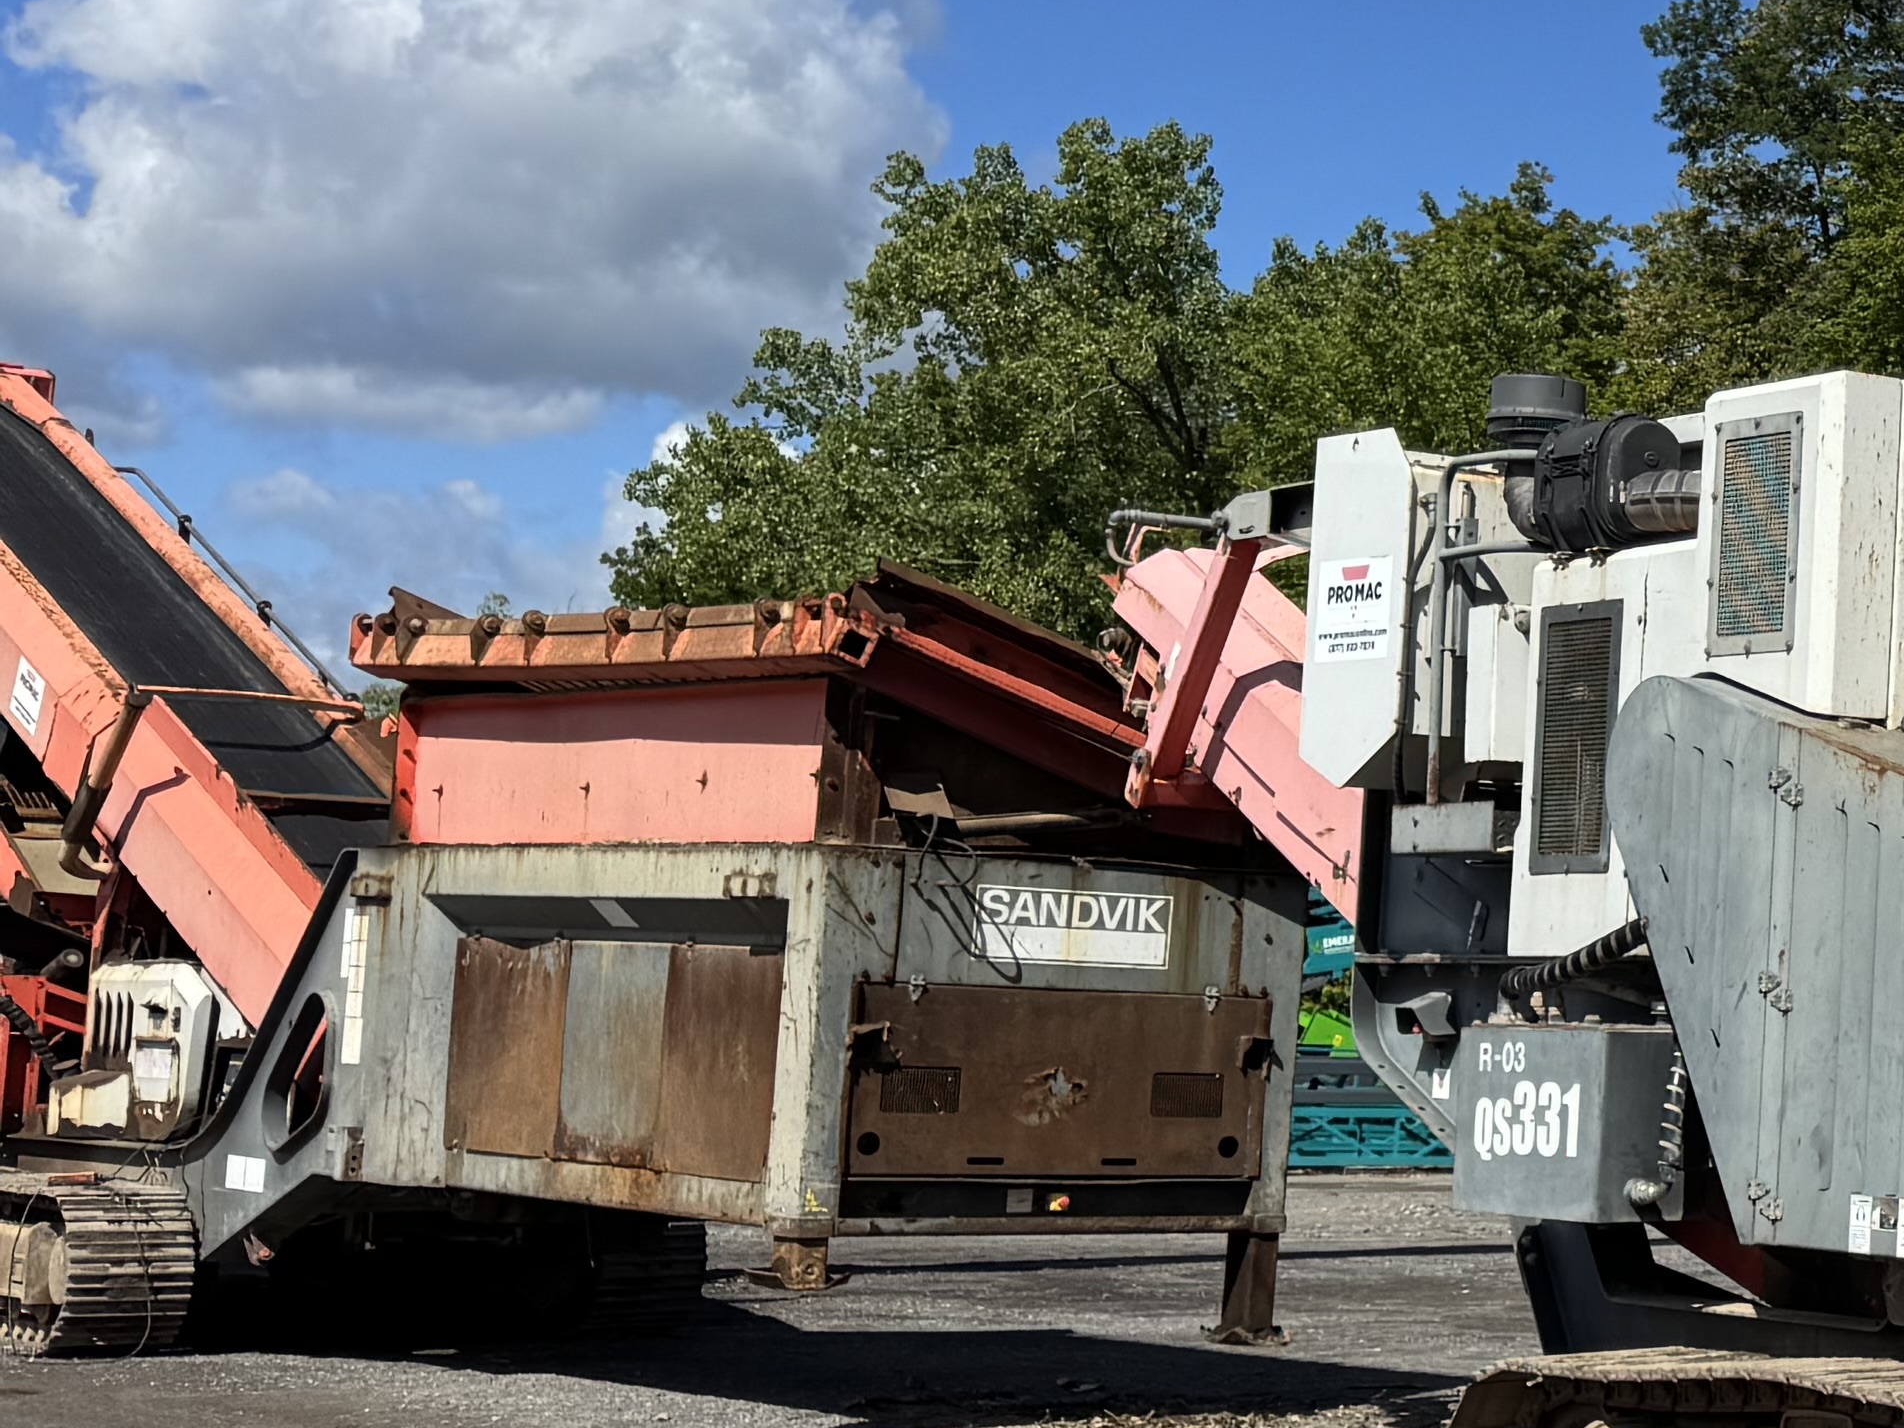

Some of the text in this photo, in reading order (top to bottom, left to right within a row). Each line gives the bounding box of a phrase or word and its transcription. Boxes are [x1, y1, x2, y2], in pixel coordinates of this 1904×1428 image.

[1327, 581, 1383, 605] PROMAC
[981, 889, 1166, 933] SANDVIK
[1479, 1041, 1526, 1073] R-03
[1473, 1080, 1581, 1161] QS331
